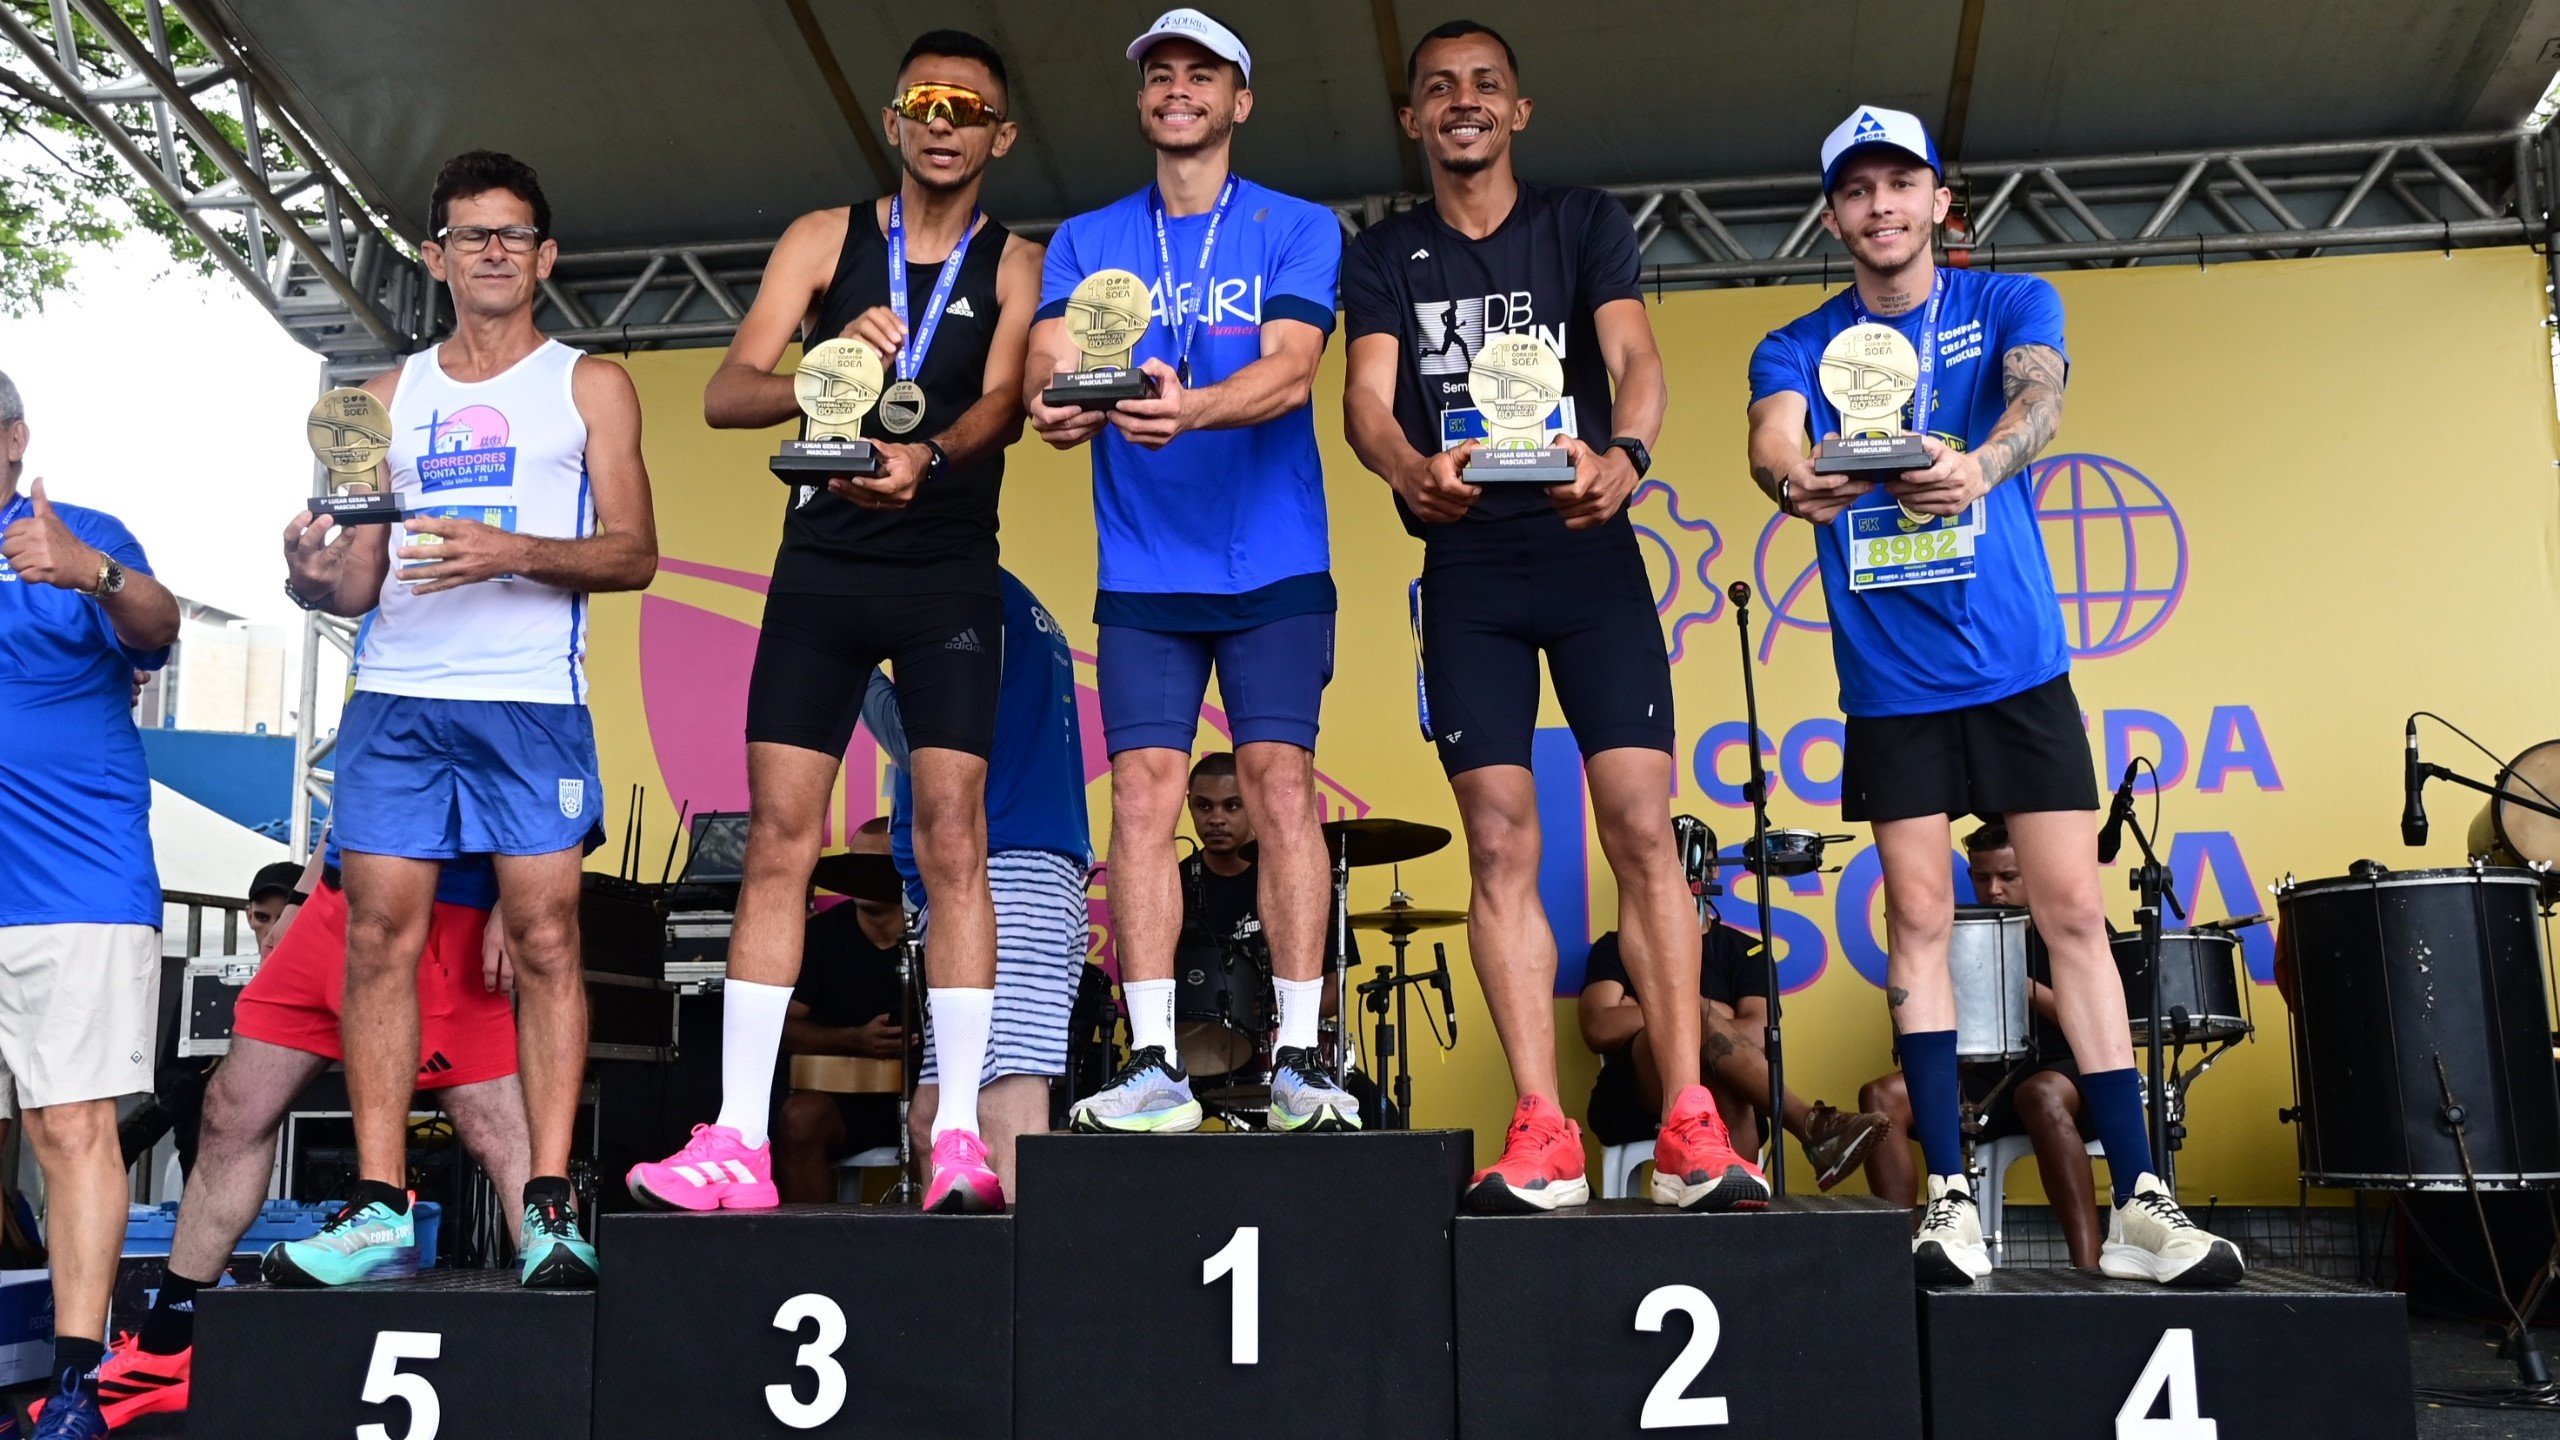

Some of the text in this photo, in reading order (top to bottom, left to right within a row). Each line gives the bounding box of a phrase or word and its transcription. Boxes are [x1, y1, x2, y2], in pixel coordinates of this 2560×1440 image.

[1105, 290, 1130, 299] SOEA
[1484, 291, 1533, 332] DB
[1865, 346, 1892, 356] SOEA
[1512, 358, 1539, 366] SOEA
[1449, 418, 1466, 433] 5K
[1853, 446, 1891, 454] MASCULINO
[422, 452, 506, 470] CORREDORES
[423, 463, 506, 480] PONTA DA FRUTA
[441, 479, 454, 487] Vila
[1858, 517, 1879, 532] 5K
[1867, 529, 1958, 567] 8982
[1693, 705, 2285, 808] CODA
[370, 1229, 394, 1243] CORRE
[1203, 1226, 1259, 1364] 1
[765, 1293, 847, 1430] 3
[1634, 1284, 1729, 1430] 2
[356, 1330, 442, 1440] 5
[2115, 1327, 2218, 1440] 4
